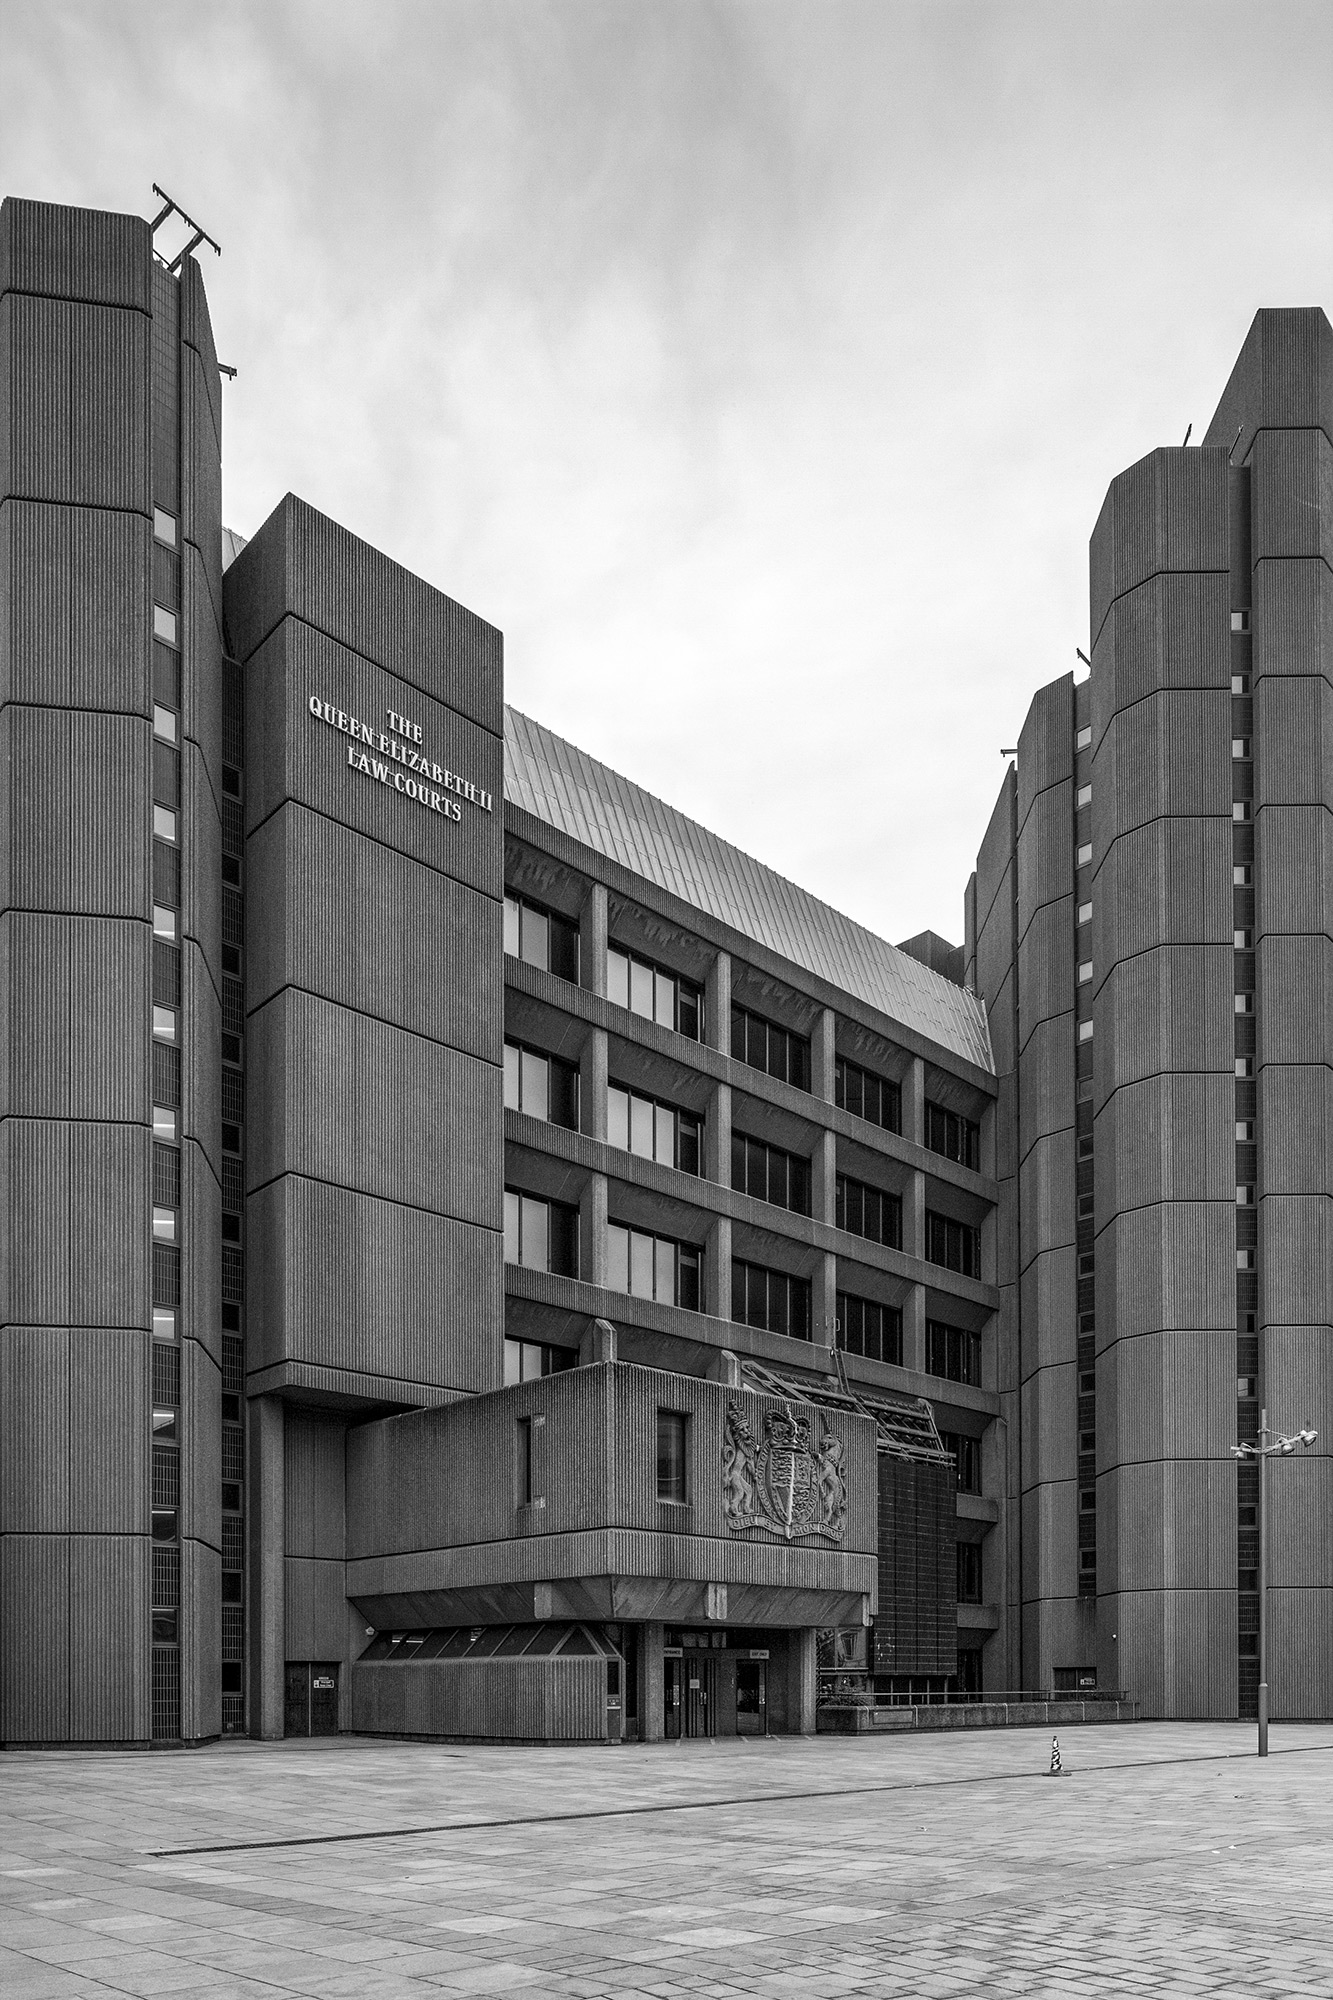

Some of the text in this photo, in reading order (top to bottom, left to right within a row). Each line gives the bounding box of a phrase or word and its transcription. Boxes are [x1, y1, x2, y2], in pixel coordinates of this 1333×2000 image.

[309, 696, 493, 812] QUEEN ELIZABETH II
[386, 709, 423, 745] THE
[347, 746, 462, 822] LAW COURTS
[794, 1524, 815, 1535] MON
